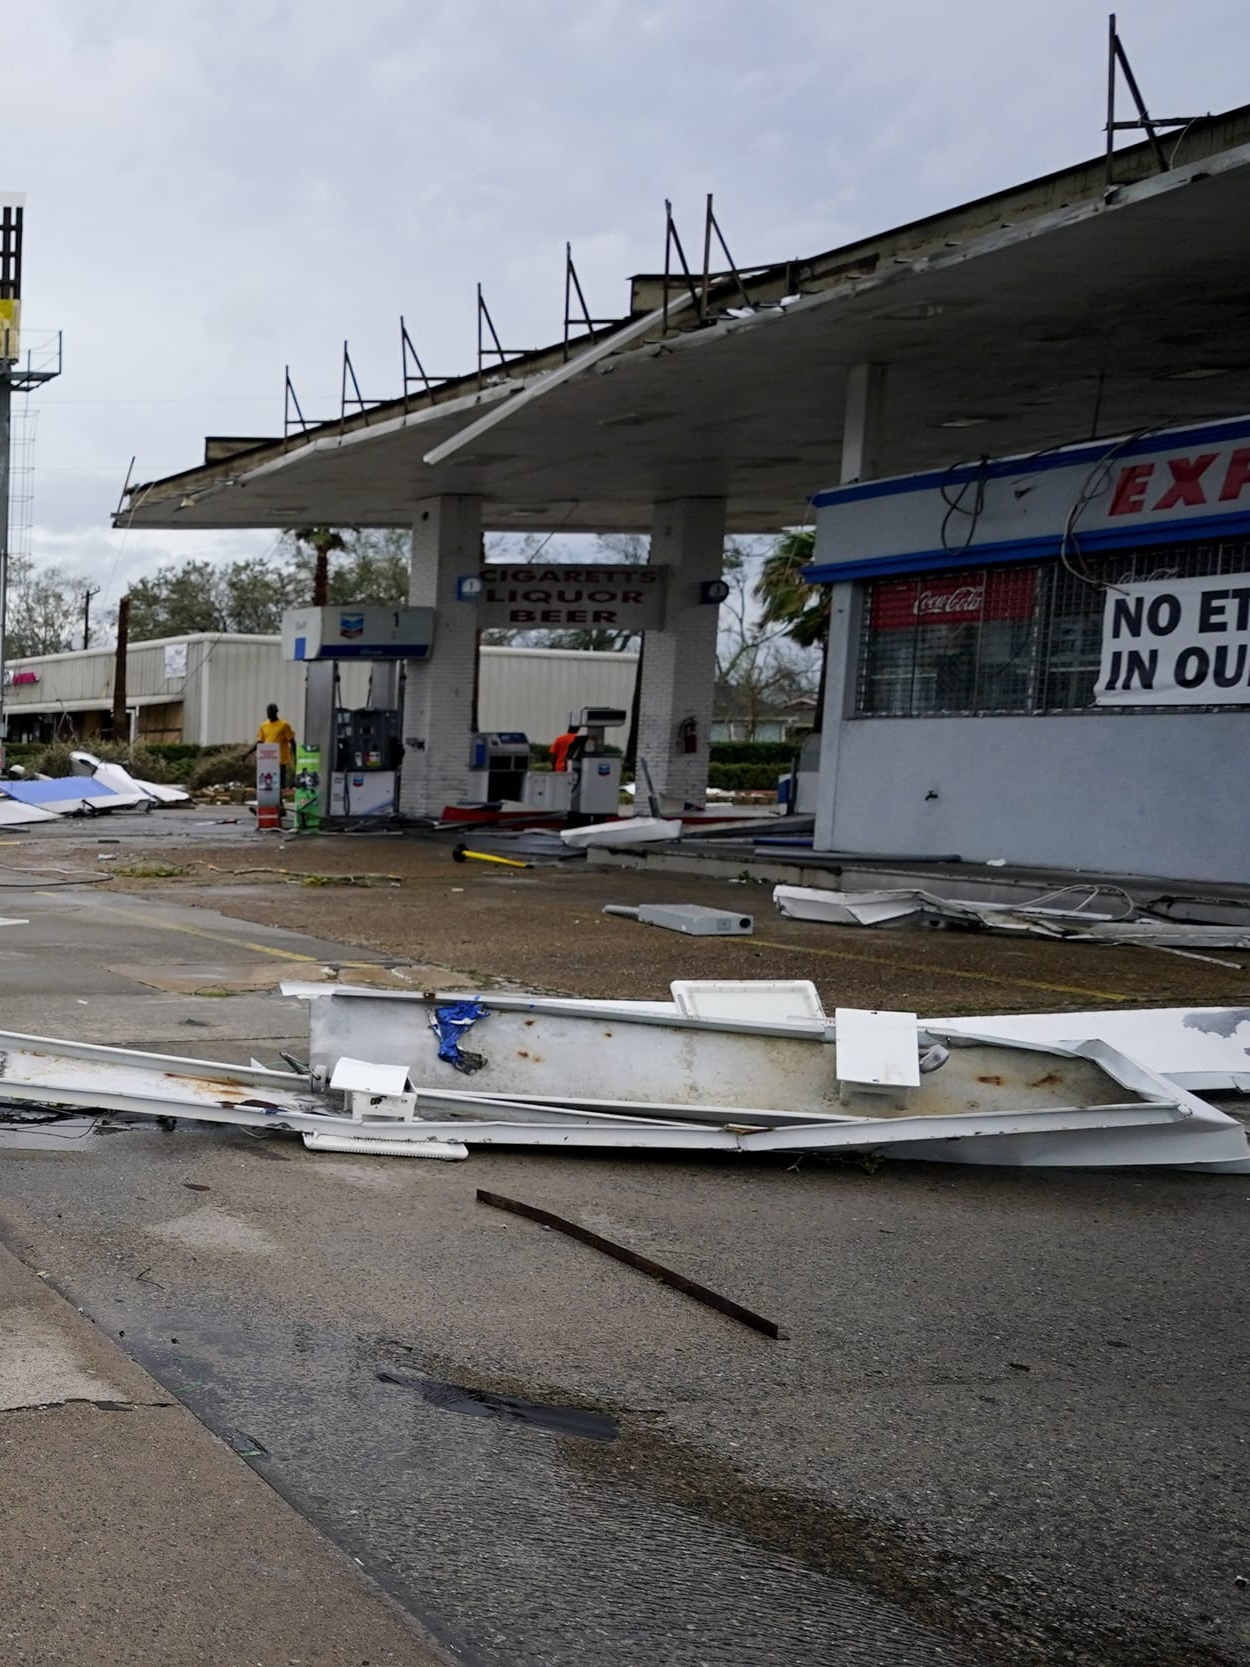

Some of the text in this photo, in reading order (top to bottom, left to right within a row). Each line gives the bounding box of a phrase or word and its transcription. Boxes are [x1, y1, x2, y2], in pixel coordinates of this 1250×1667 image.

[486, 589, 646, 604] LIQUOR
[509, 609, 618, 624] BEER
[1112, 593, 1182, 640] NO
[1105, 643, 1250, 692] IN OU
